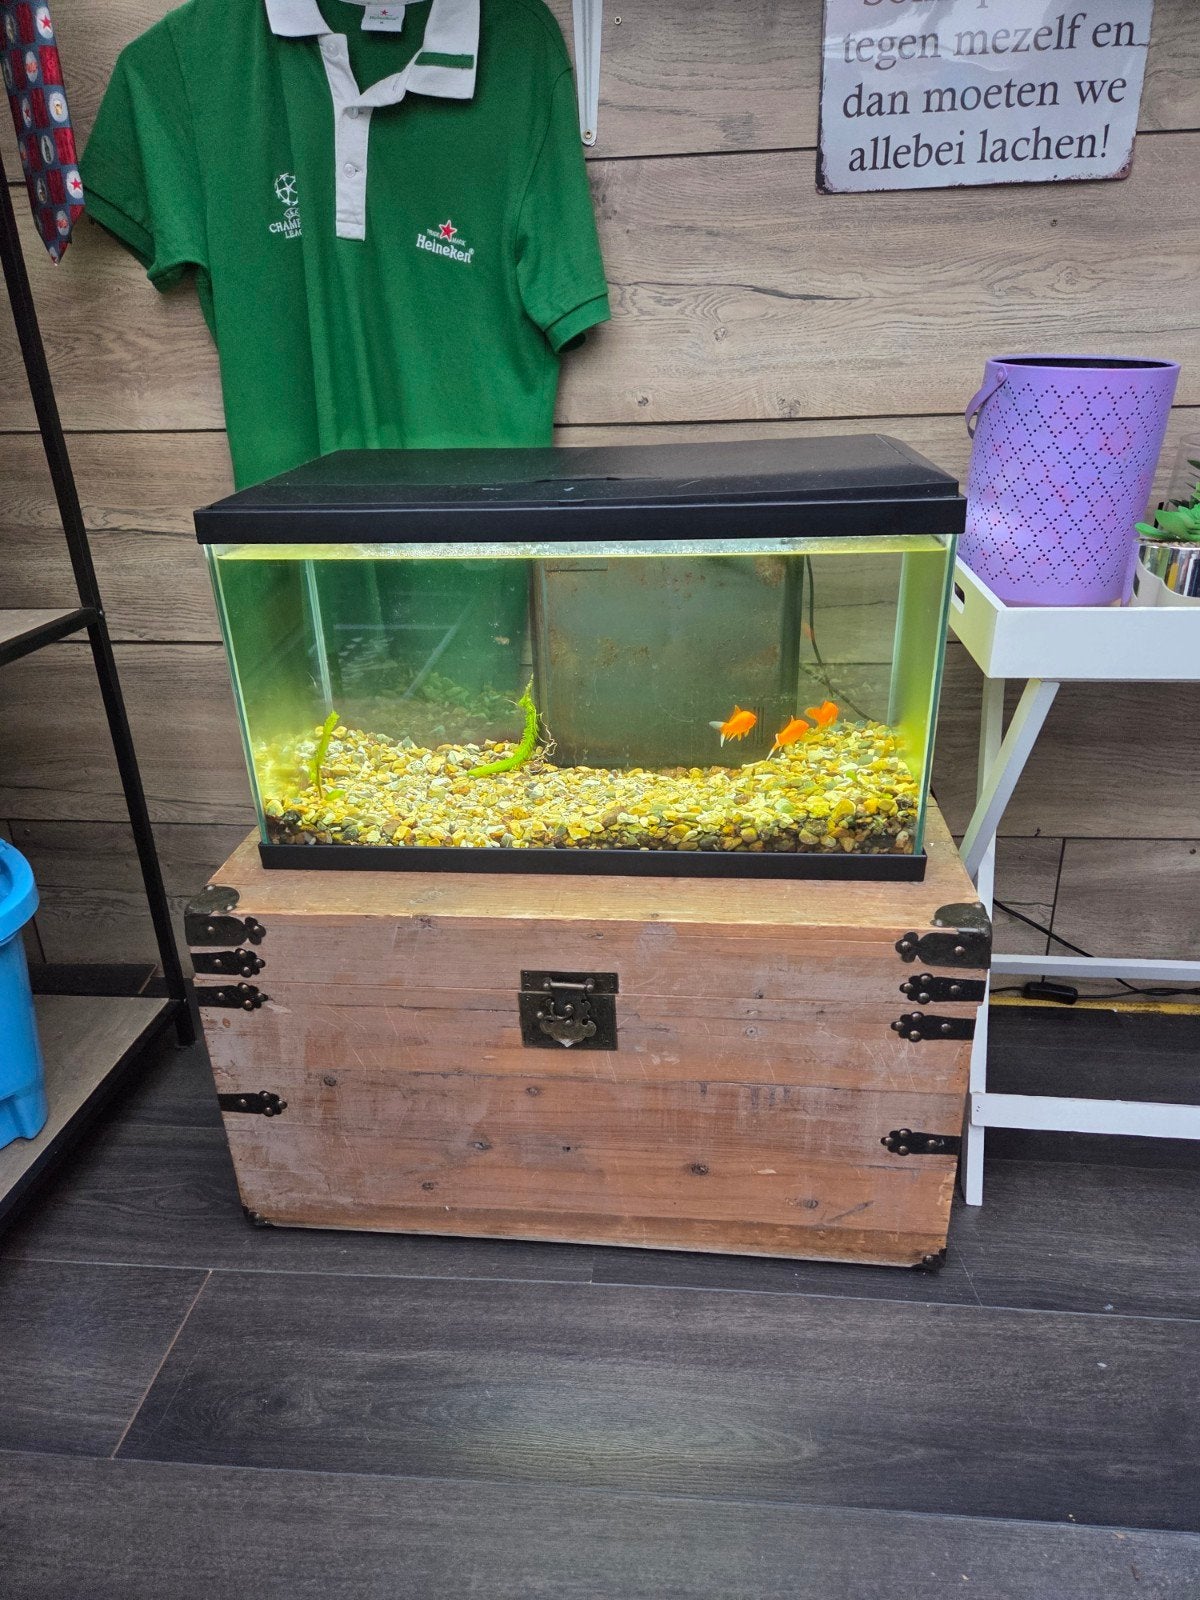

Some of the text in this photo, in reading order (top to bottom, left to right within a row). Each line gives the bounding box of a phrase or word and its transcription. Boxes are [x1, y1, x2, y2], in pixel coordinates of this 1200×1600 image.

[843, 13, 1136, 70] tegen mezelf en
[842, 77, 1127, 118] dan moeten we
[848, 124, 1111, 171] allebei lachen!
